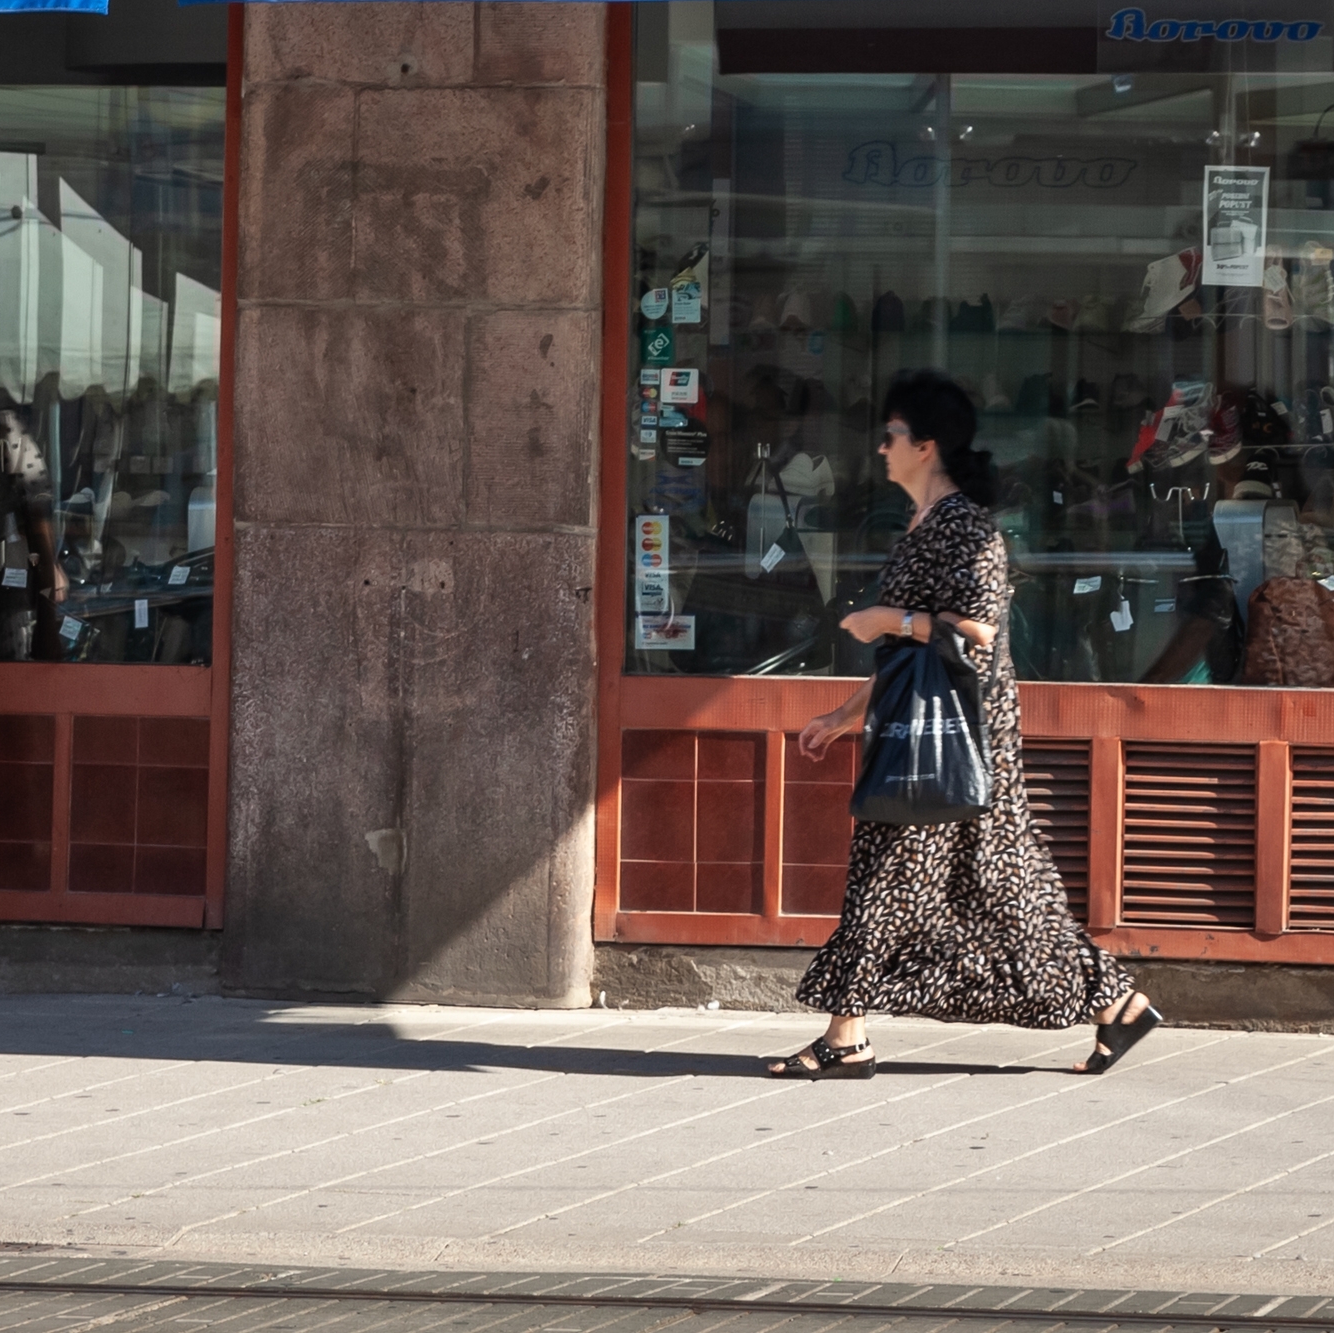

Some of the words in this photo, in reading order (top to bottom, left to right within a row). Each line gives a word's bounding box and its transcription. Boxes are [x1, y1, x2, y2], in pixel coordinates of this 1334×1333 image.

[1105, 8, 1324, 44] Borovo
[842, 140, 1138, 188] Borovo
[1212, 175, 1260, 187] Borovo
